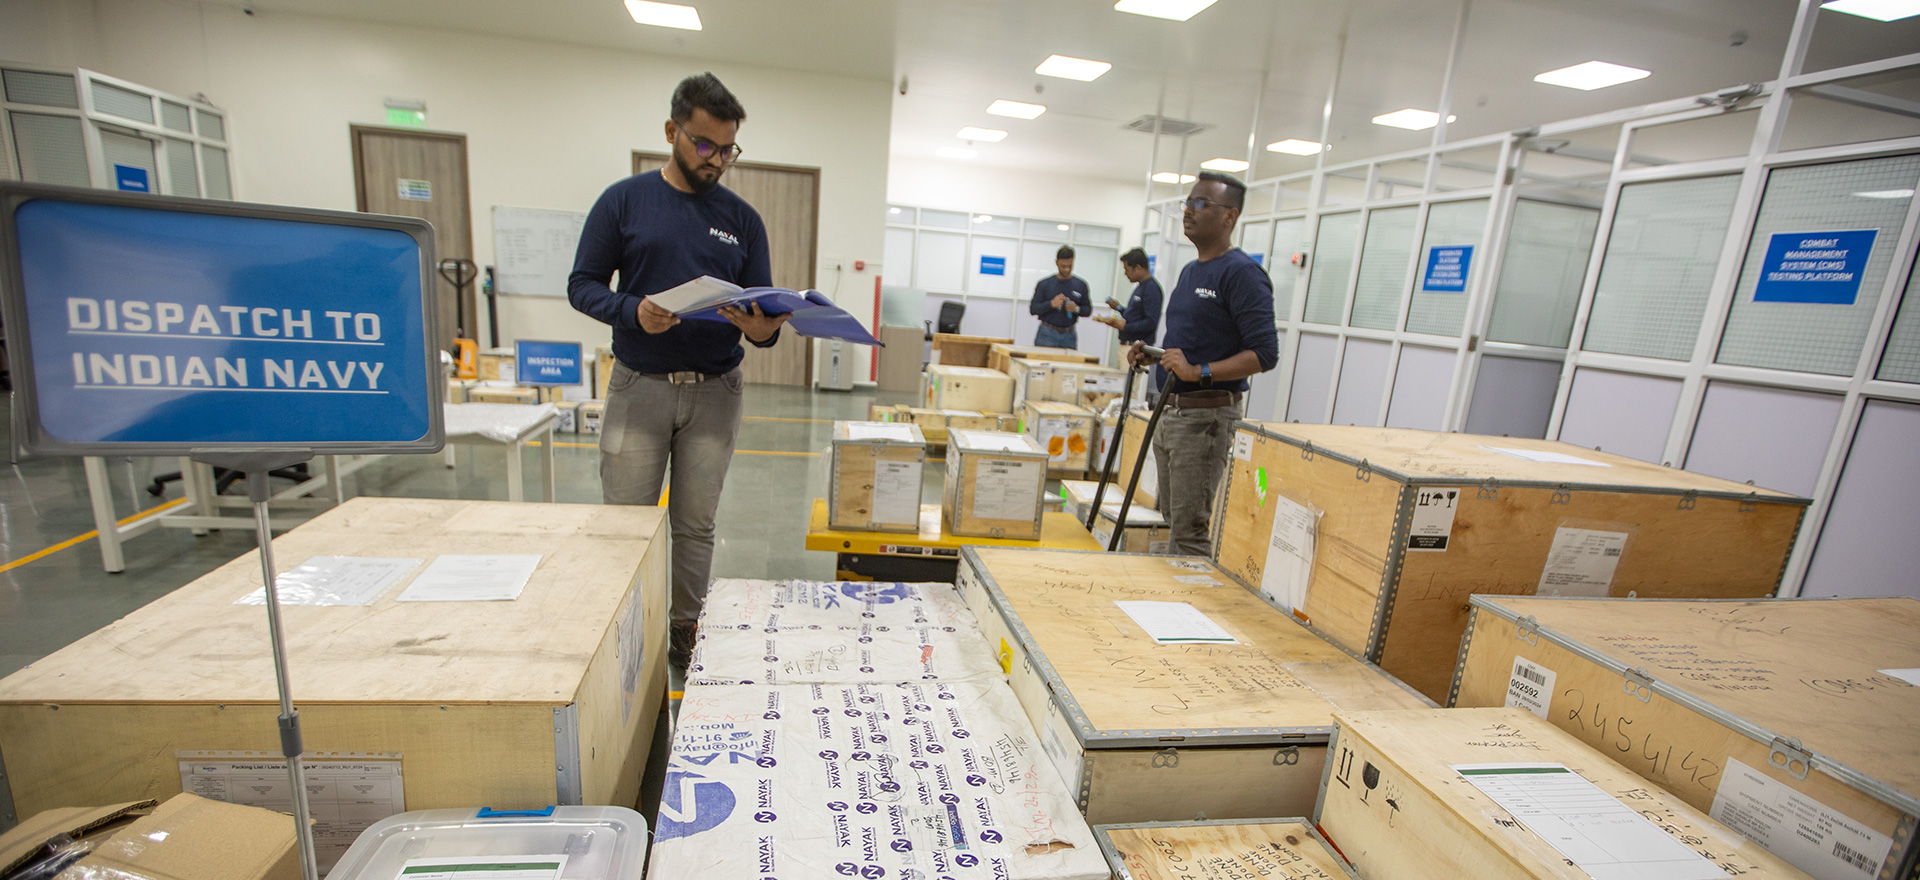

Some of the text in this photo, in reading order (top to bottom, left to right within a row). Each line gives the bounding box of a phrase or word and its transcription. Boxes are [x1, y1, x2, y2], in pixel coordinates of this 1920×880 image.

[709, 227, 739, 245] NAVAL
[1800, 239, 1839, 248] COMBAT
[1780, 260, 1846, 270] SYSTEM (CMS)
[1784, 250, 1848, 259] MANAGEMENT
[1767, 272, 1853, 281] TESTING PLATFORM
[67, 298, 381, 341] DISPATCH TO
[72, 352, 384, 389] INDIAN NAVY
[527, 356, 574, 366] INSPECTION
[540, 366, 562, 376] AREA
[1510, 678, 1538, 698] 002592
[761, 729, 773, 755] NAYAK
[851, 726, 862, 750] NAYAK
[922, 720, 935, 743] NAYAK
[857, 770, 868, 800] NAYAK
[934, 764, 950, 790] NAYAK
[758, 778, 768, 808] NAYAK
[888, 804, 902, 836] NAYAK
[974, 797, 991, 827] NAYAK
[838, 814, 852, 848] NAYAK
[862, 826, 875, 862] NAYAK
[759, 836, 770, 873] NAYAK
